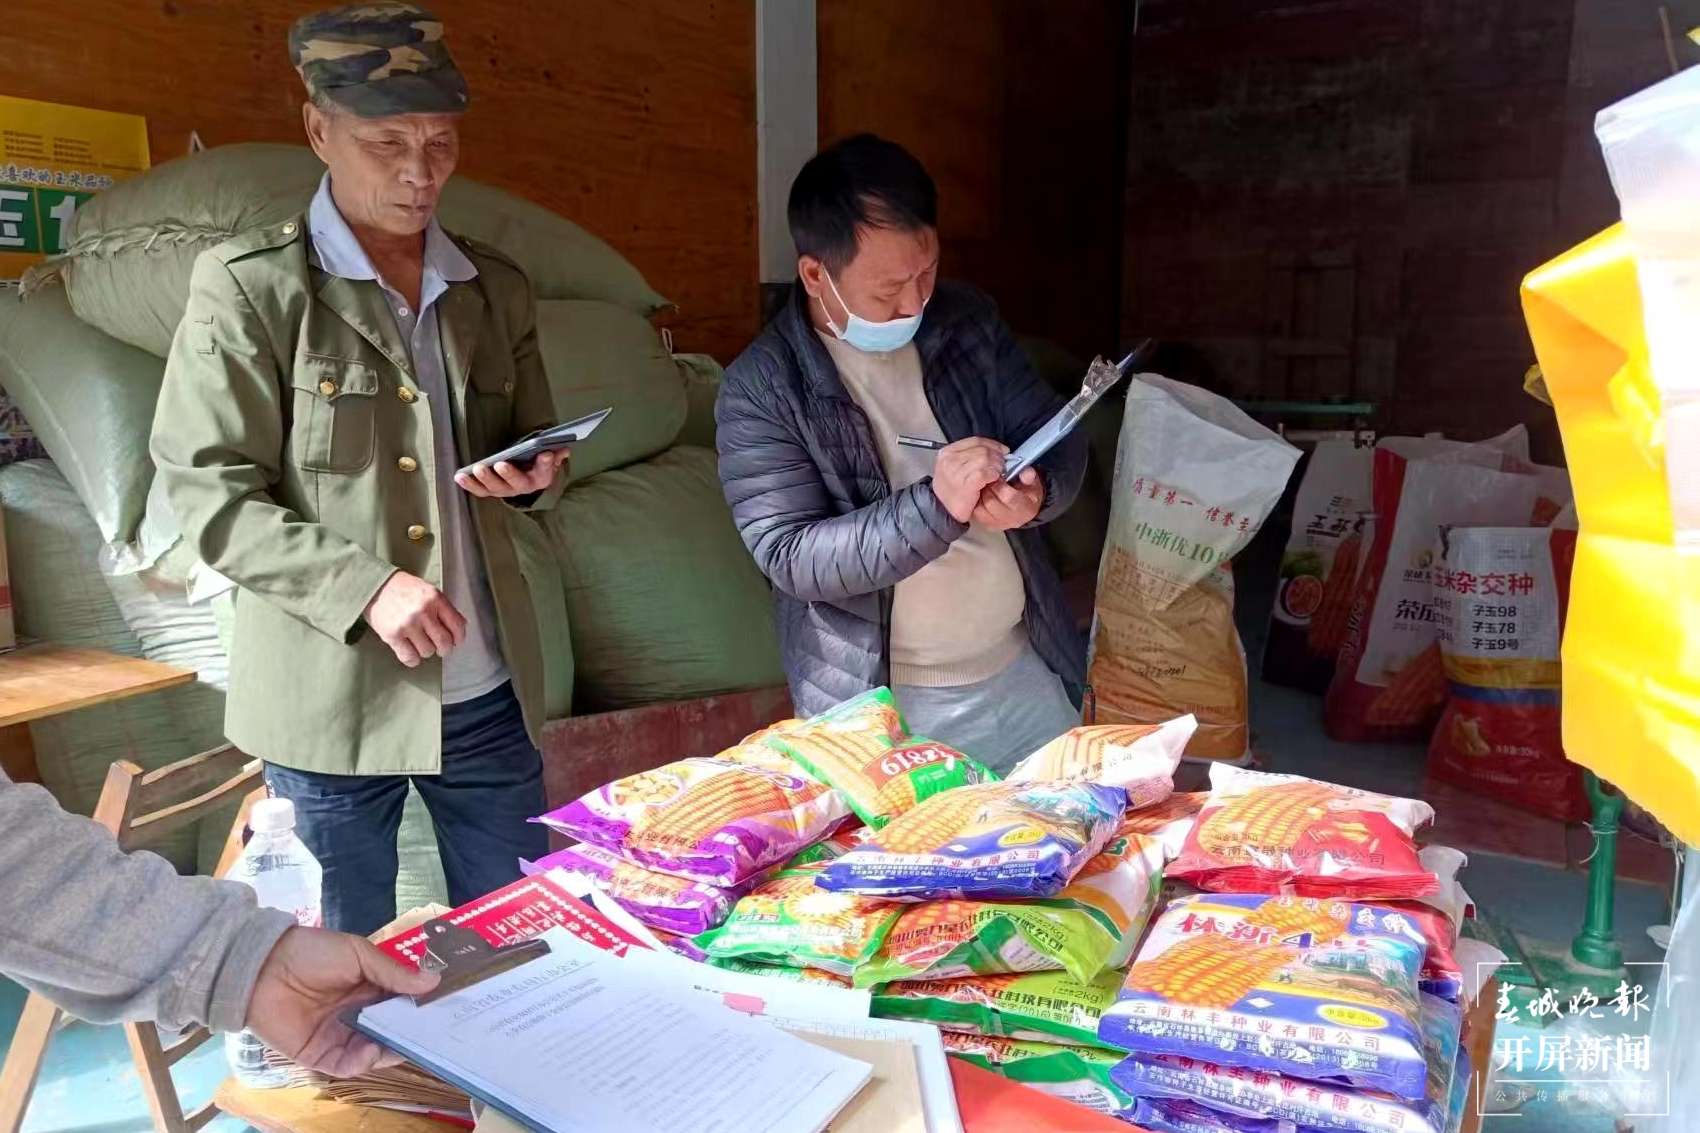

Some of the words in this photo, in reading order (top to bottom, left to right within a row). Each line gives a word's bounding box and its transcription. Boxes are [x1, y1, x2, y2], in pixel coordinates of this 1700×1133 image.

[0, 165, 113, 189] 喜欢的玉米品种
[1132, 1001, 1381, 1052] 云南林丰种业有限公司
